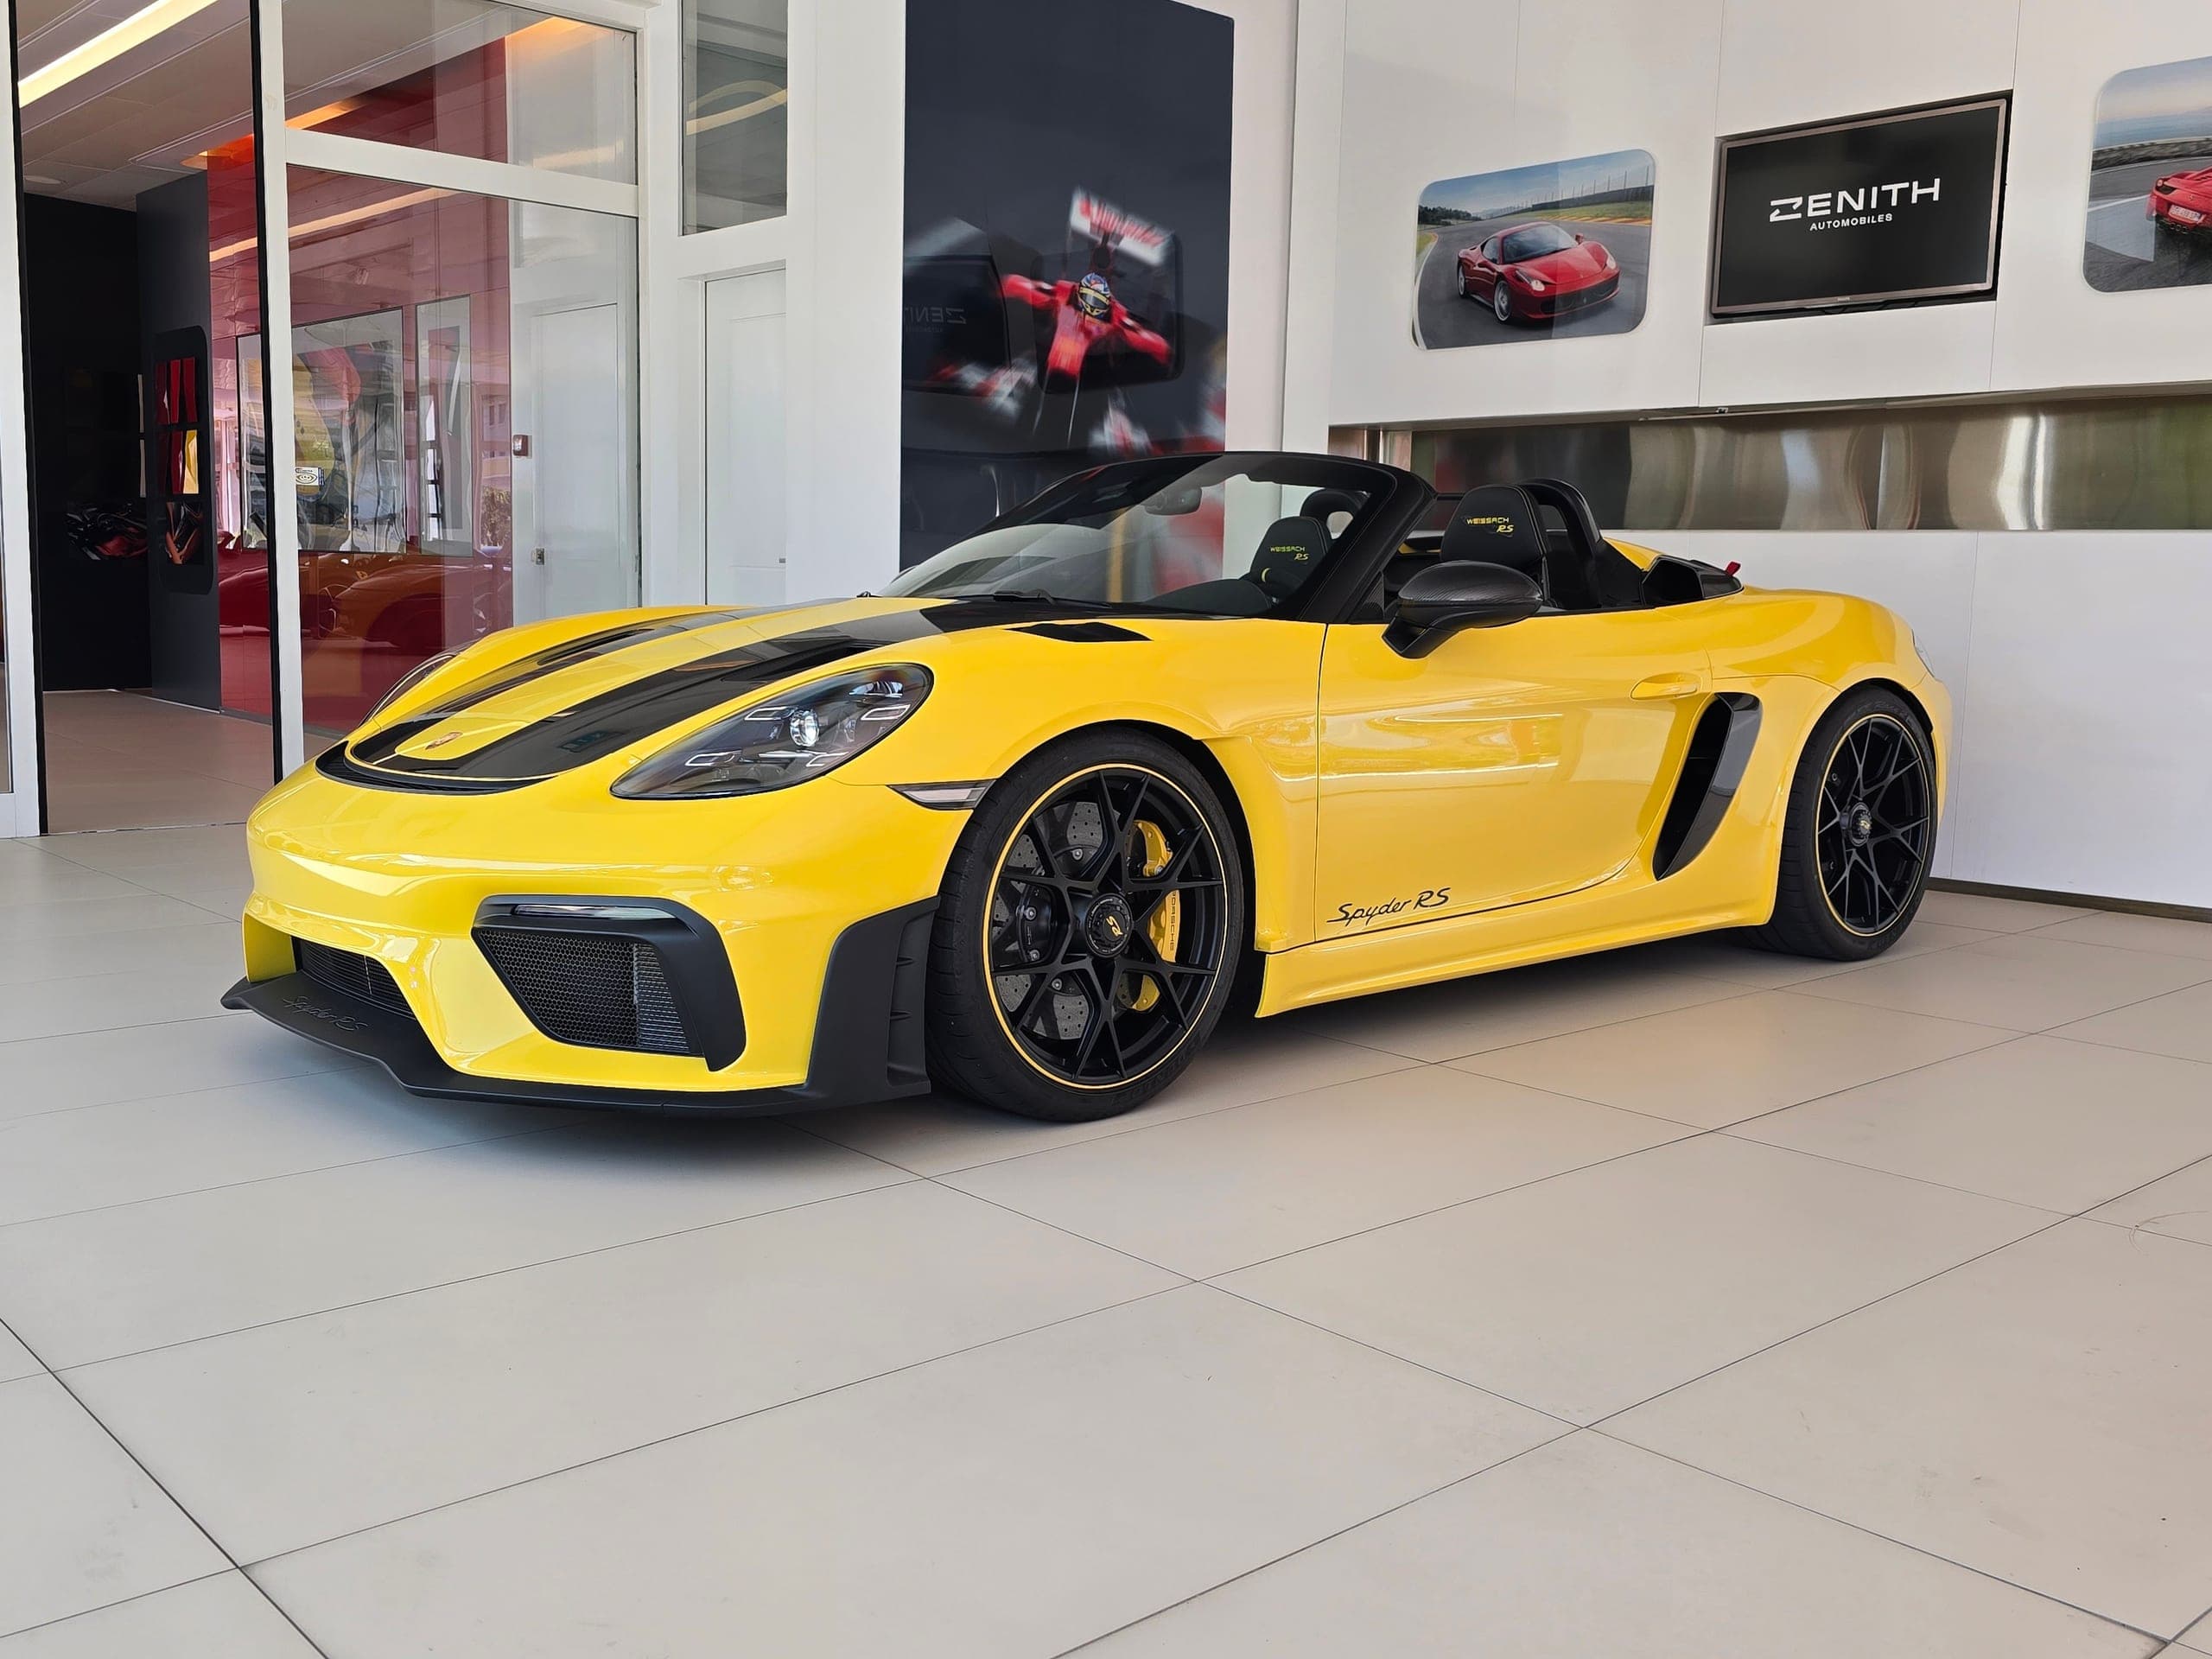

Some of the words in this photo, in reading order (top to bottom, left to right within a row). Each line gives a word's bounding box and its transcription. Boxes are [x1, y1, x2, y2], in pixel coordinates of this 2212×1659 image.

[1769, 177, 1941, 222] ZENITH
[1809, 213, 1893, 232] AUTOMOBILES
[1496, 524, 1515, 533] RS
[1294, 552, 1310, 561] RS
[1326, 897, 1412, 927] Spyder
[1413, 887, 1452, 911] RS
